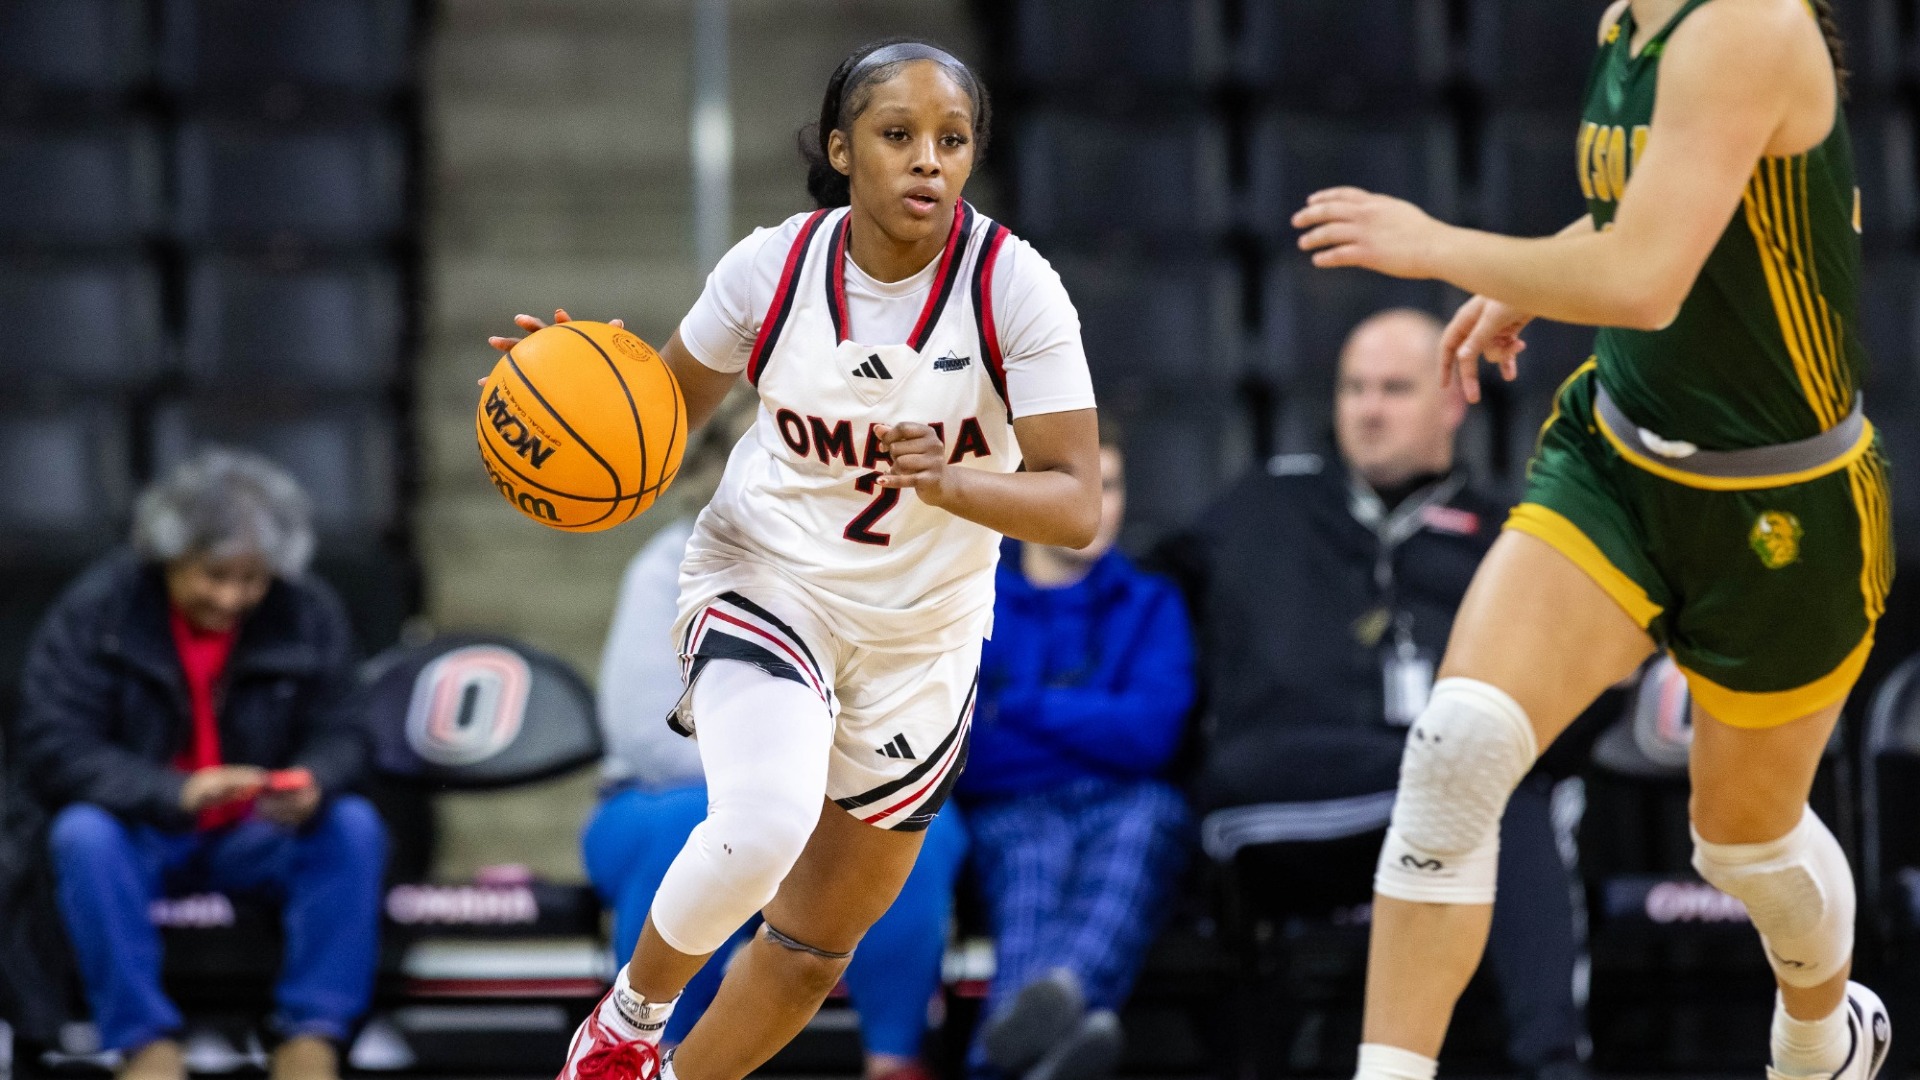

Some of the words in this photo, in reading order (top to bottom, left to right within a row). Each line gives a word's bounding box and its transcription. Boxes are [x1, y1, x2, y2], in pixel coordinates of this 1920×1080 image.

[933, 357, 971, 370] SUMMIT
[484, 385, 556, 470] NCAA
[528, 416, 562, 447] OFFICIAL
[776, 408, 992, 469] OMAA
[843, 470, 902, 546] 2
